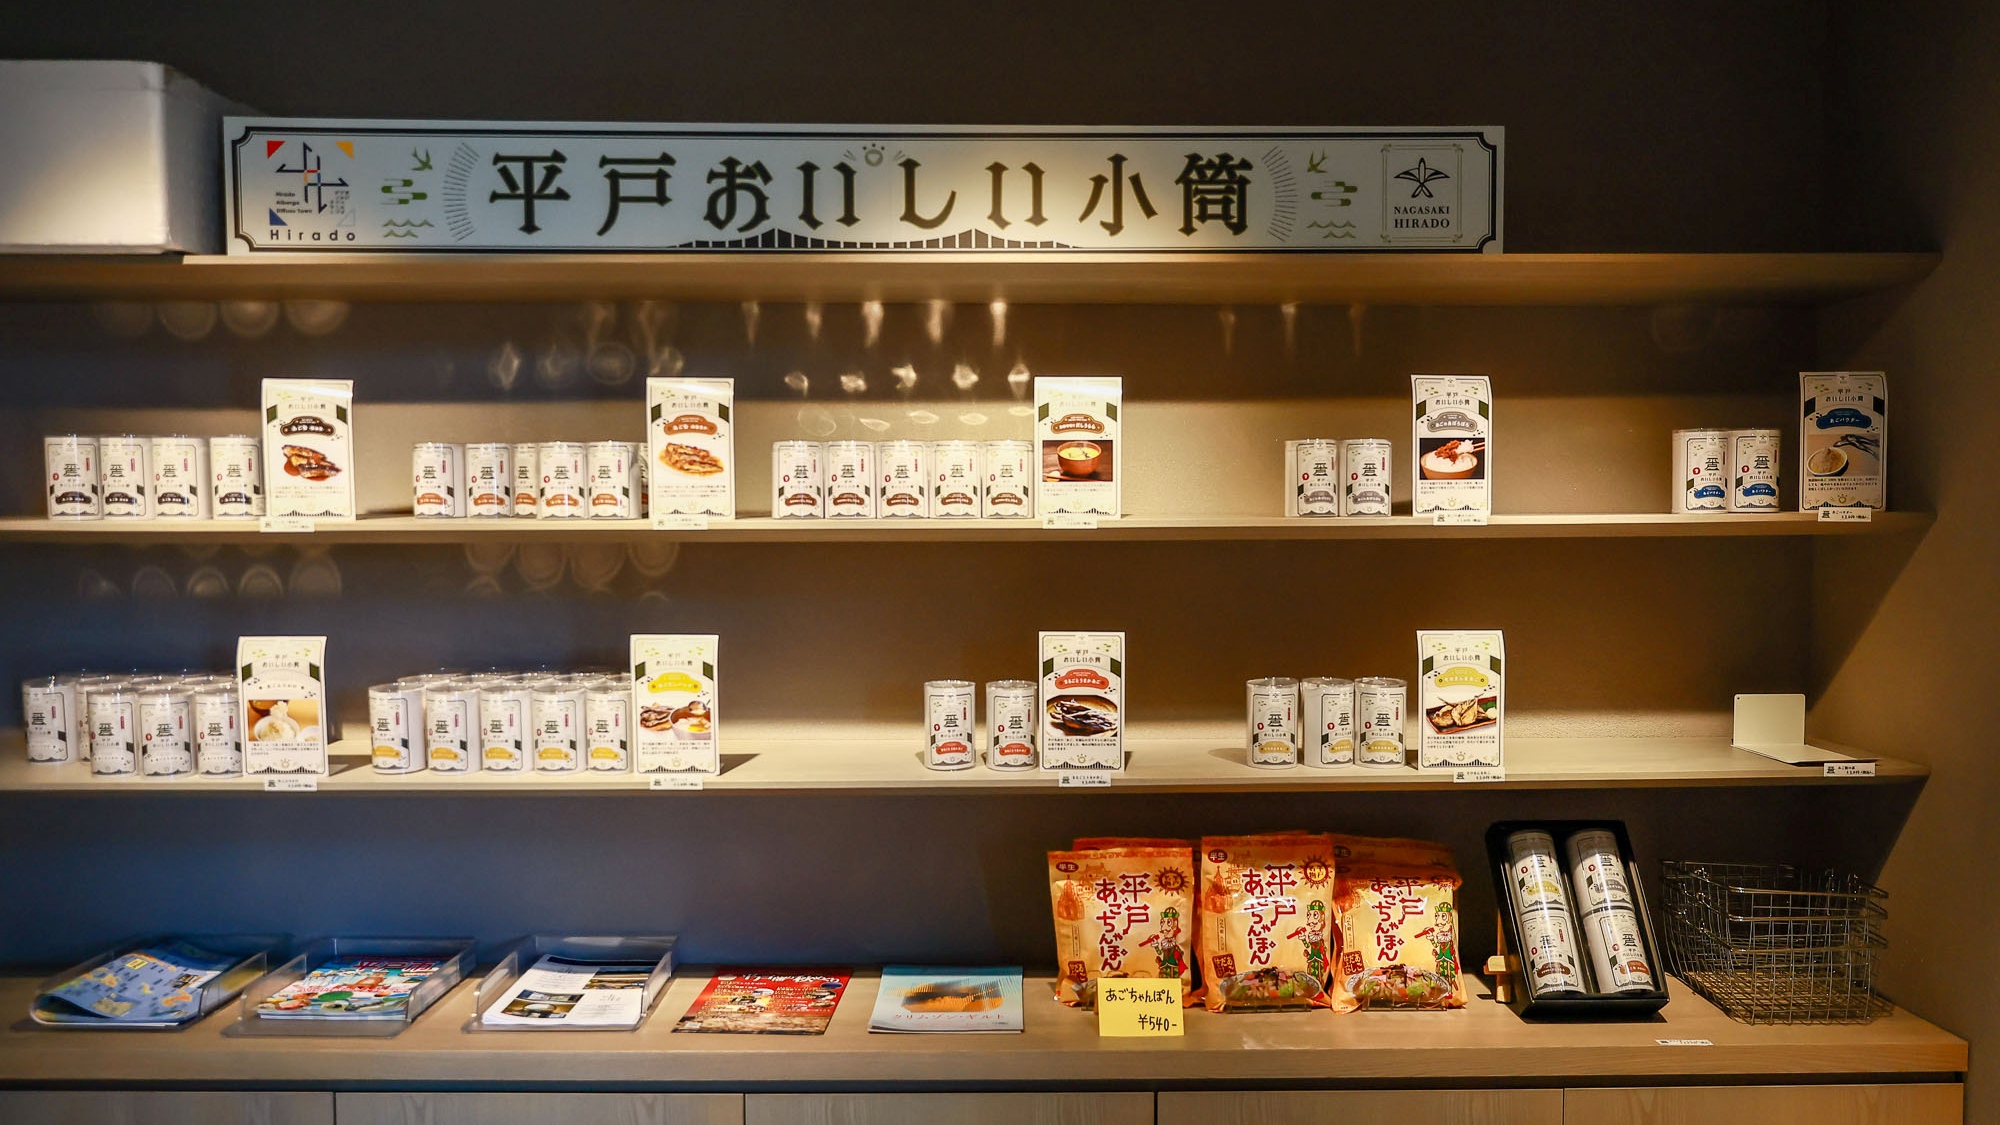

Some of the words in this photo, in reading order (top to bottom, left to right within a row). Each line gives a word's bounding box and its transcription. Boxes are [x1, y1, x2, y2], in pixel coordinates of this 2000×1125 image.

[489, 149, 1254, 237] 平戸おいしい小筒
[1394, 205, 1450, 215] NAGASAKI
[1394, 218, 1450, 229] HIRADO
[270, 229, 356, 242] Hirado
[1094, 878, 1128, 972] あごちゃんぽん
[1118, 873, 1153, 936] 平戸
[1241, 869, 1276, 966] あごちゃんぽん
[1264, 864, 1298, 927] 平戸
[1369, 877, 1405, 962] あごちゃんぽん
[1393, 876, 1425, 926] 平戸
[1105, 988, 1175, 1004] あごちゃんぽん
